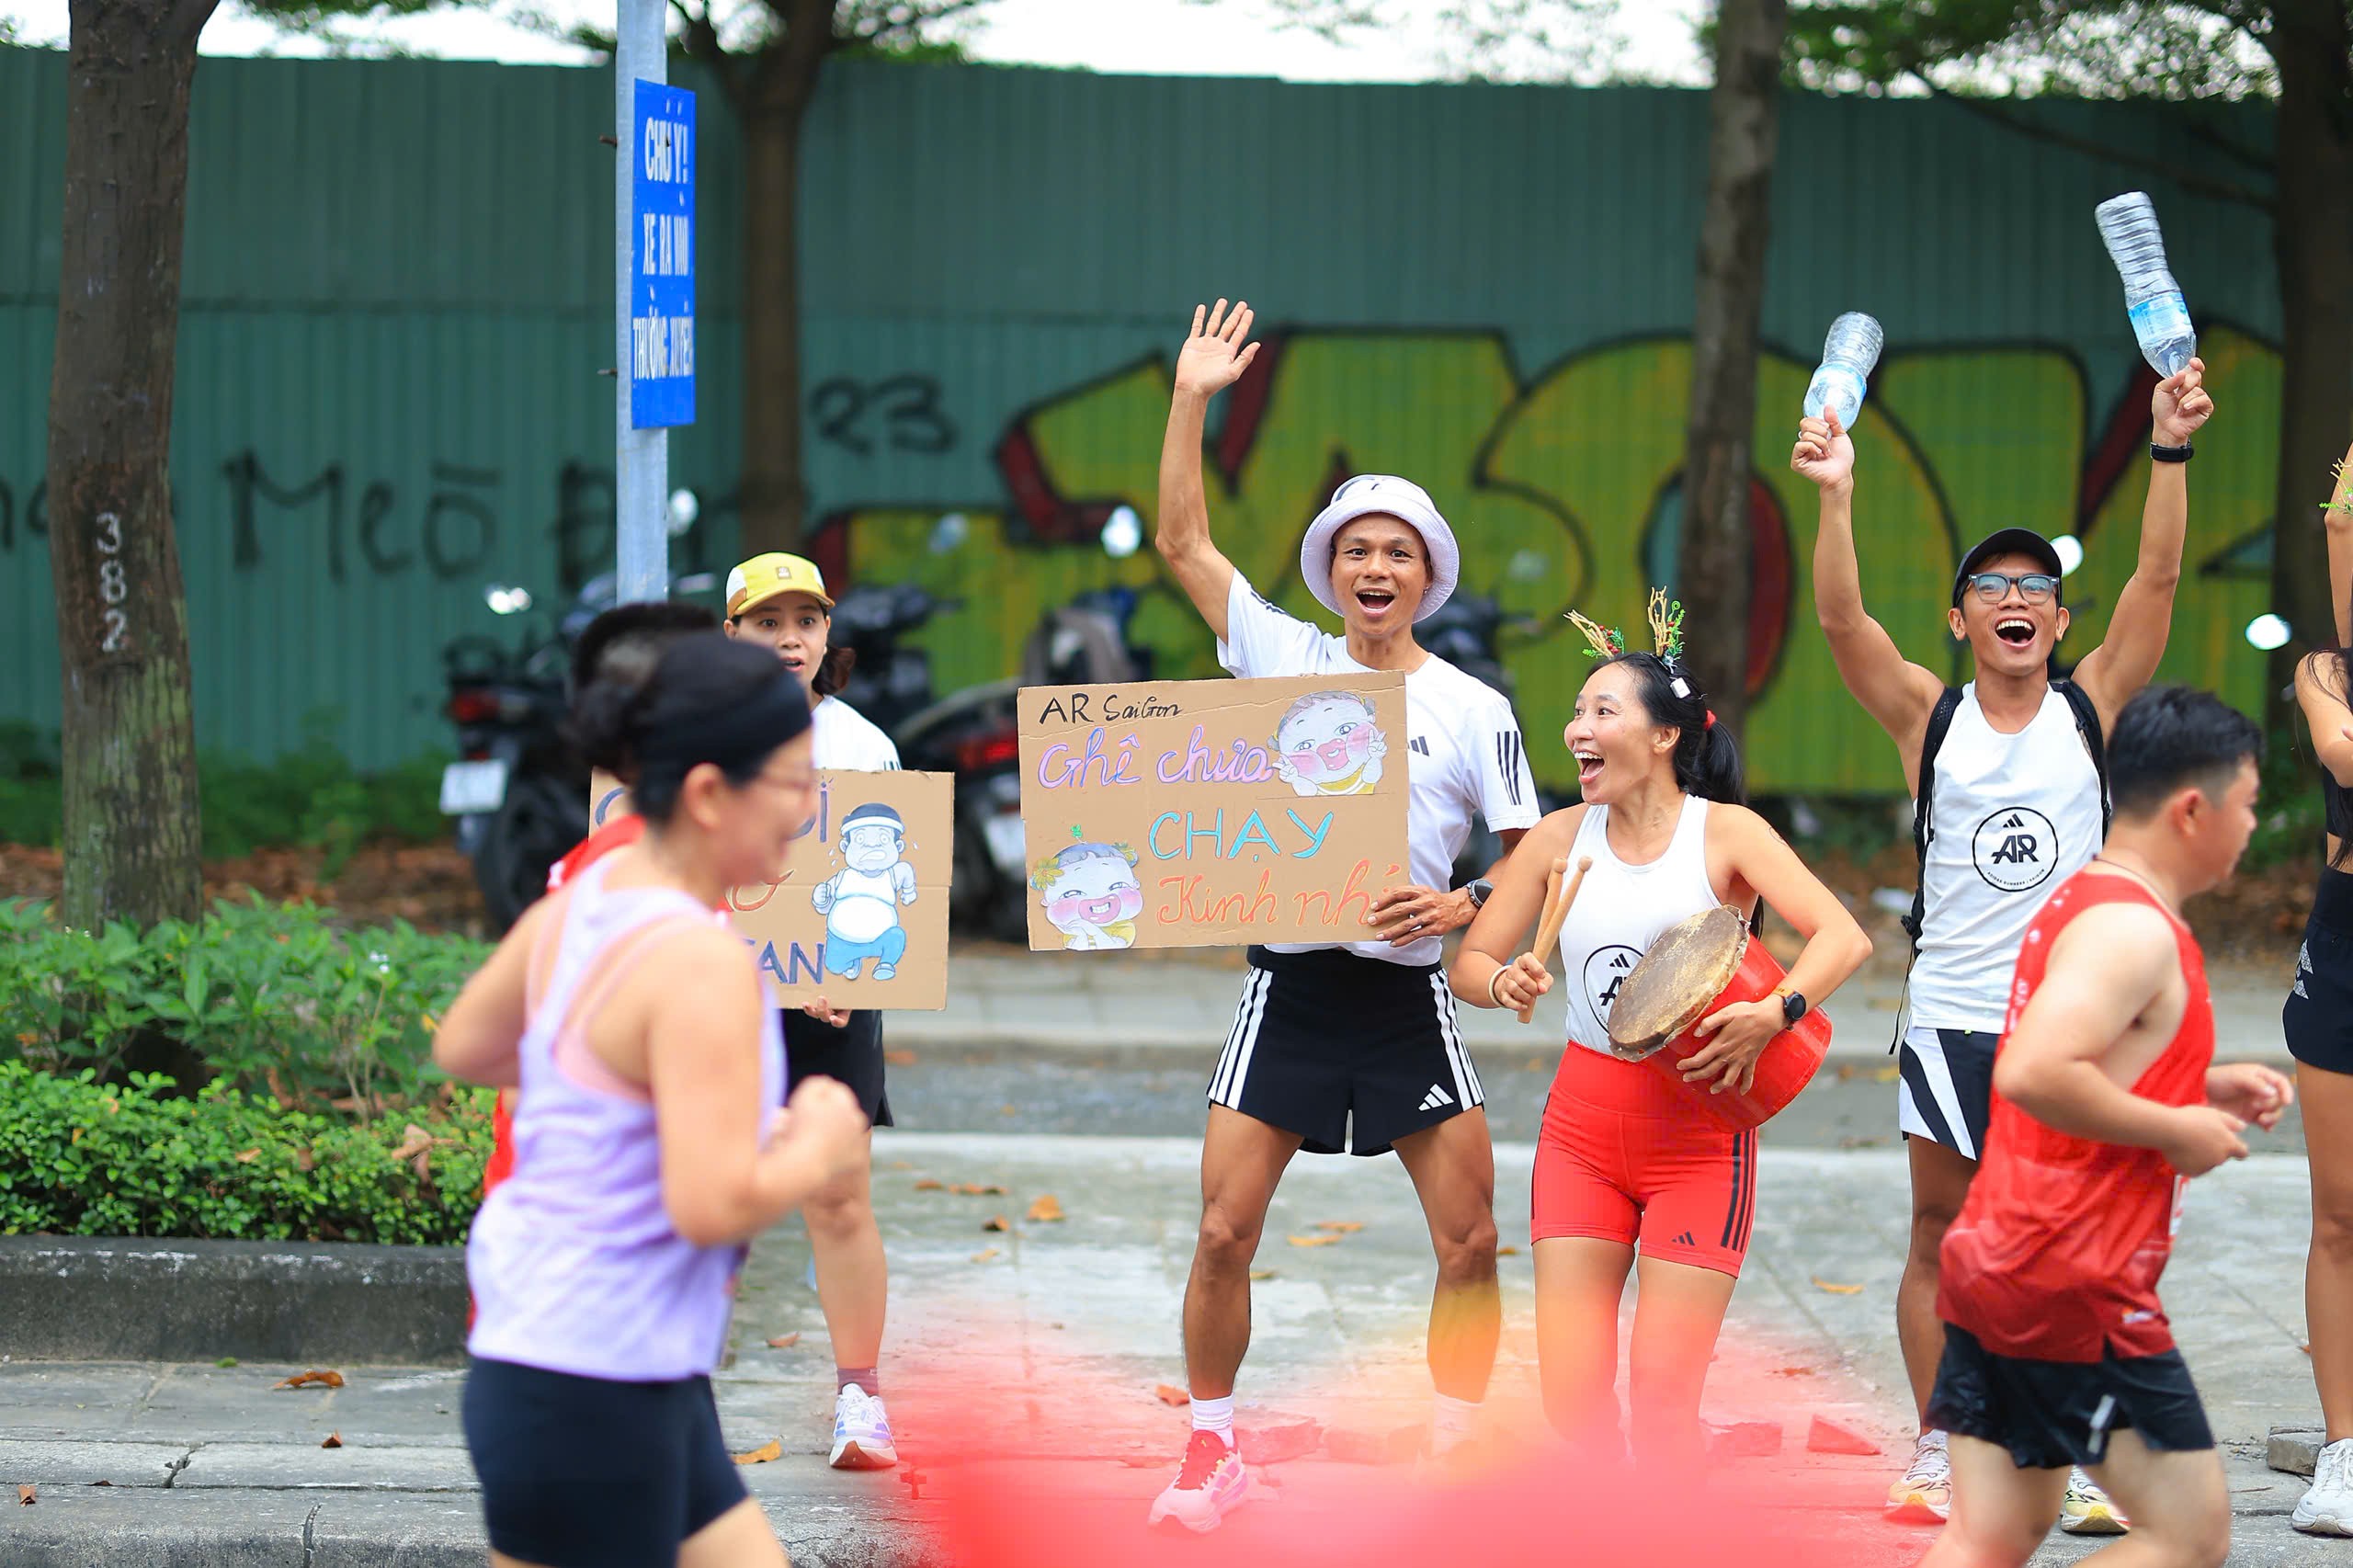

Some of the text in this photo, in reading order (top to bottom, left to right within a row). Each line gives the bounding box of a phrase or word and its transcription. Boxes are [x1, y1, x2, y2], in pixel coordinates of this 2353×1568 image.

[644, 99, 688, 184] CHÚ Ý!
[643, 212, 655, 275] XE
[660, 213, 672, 276] RA
[809, 371, 961, 457] 23
[97, 511, 128, 653] 382
[1039, 692, 1094, 724] AR
[1038, 724, 1276, 789] Ghê chưa
[1149, 808, 1334, 862] CHẠY
[1991, 834, 2040, 864] AR
[1156, 868, 1279, 926] Kinh
[1598, 976, 1627, 1006] A
